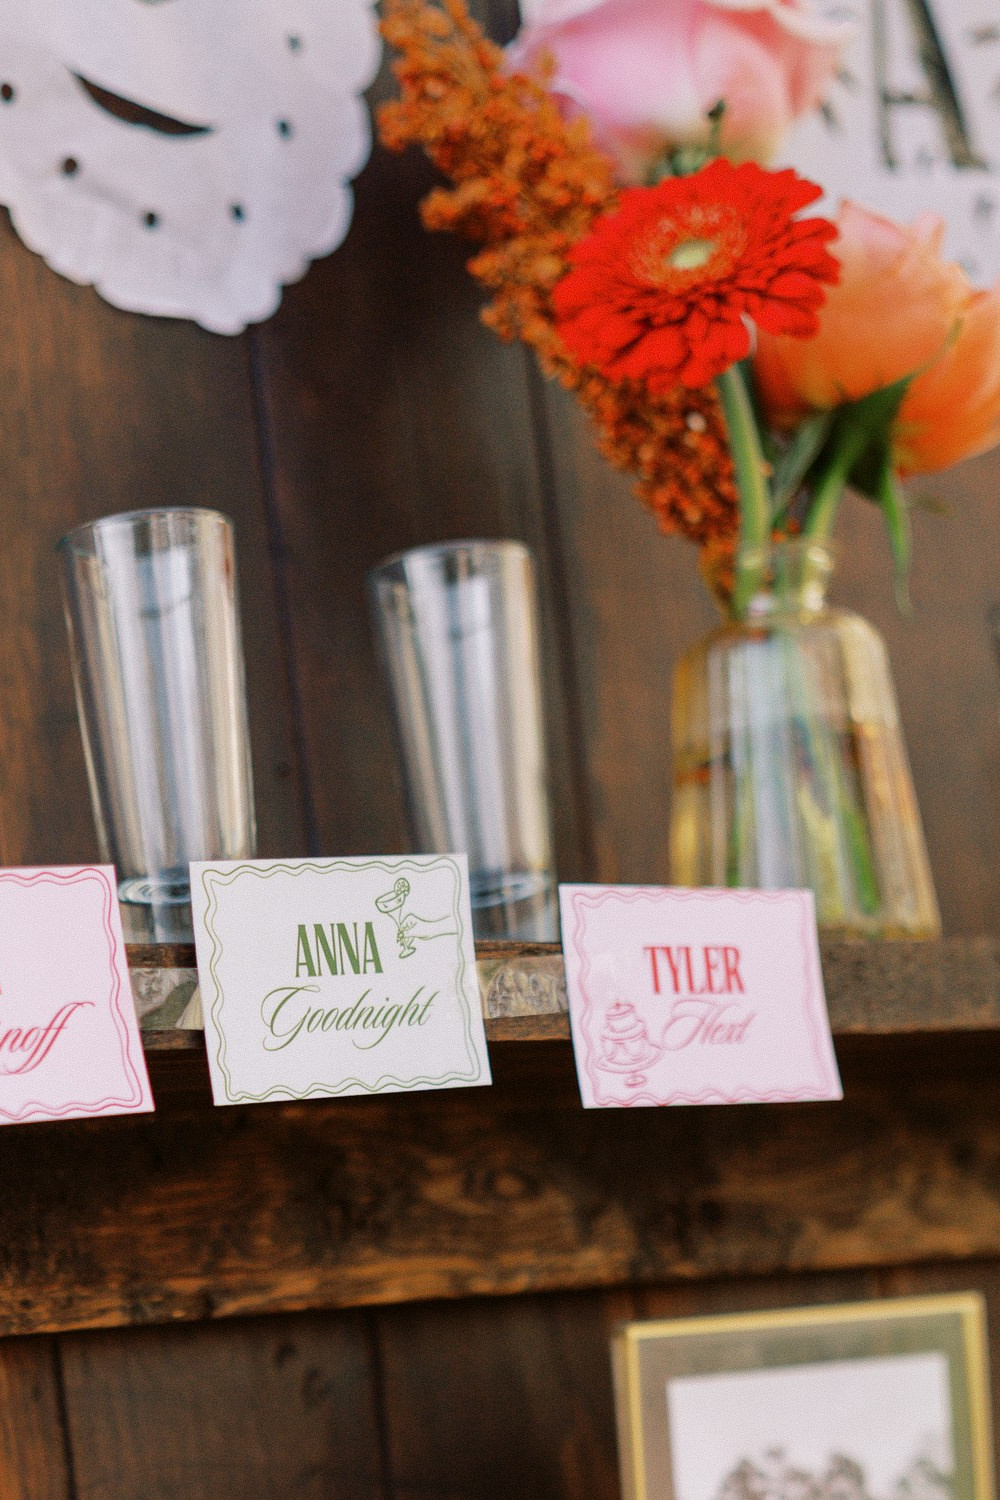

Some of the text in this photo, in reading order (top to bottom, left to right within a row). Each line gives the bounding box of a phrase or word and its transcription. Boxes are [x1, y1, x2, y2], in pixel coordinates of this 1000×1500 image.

[295, 921, 384, 978] ANNA
[643, 945, 746, 995] TYLER
[261, 984, 441, 1052] Goodnight
